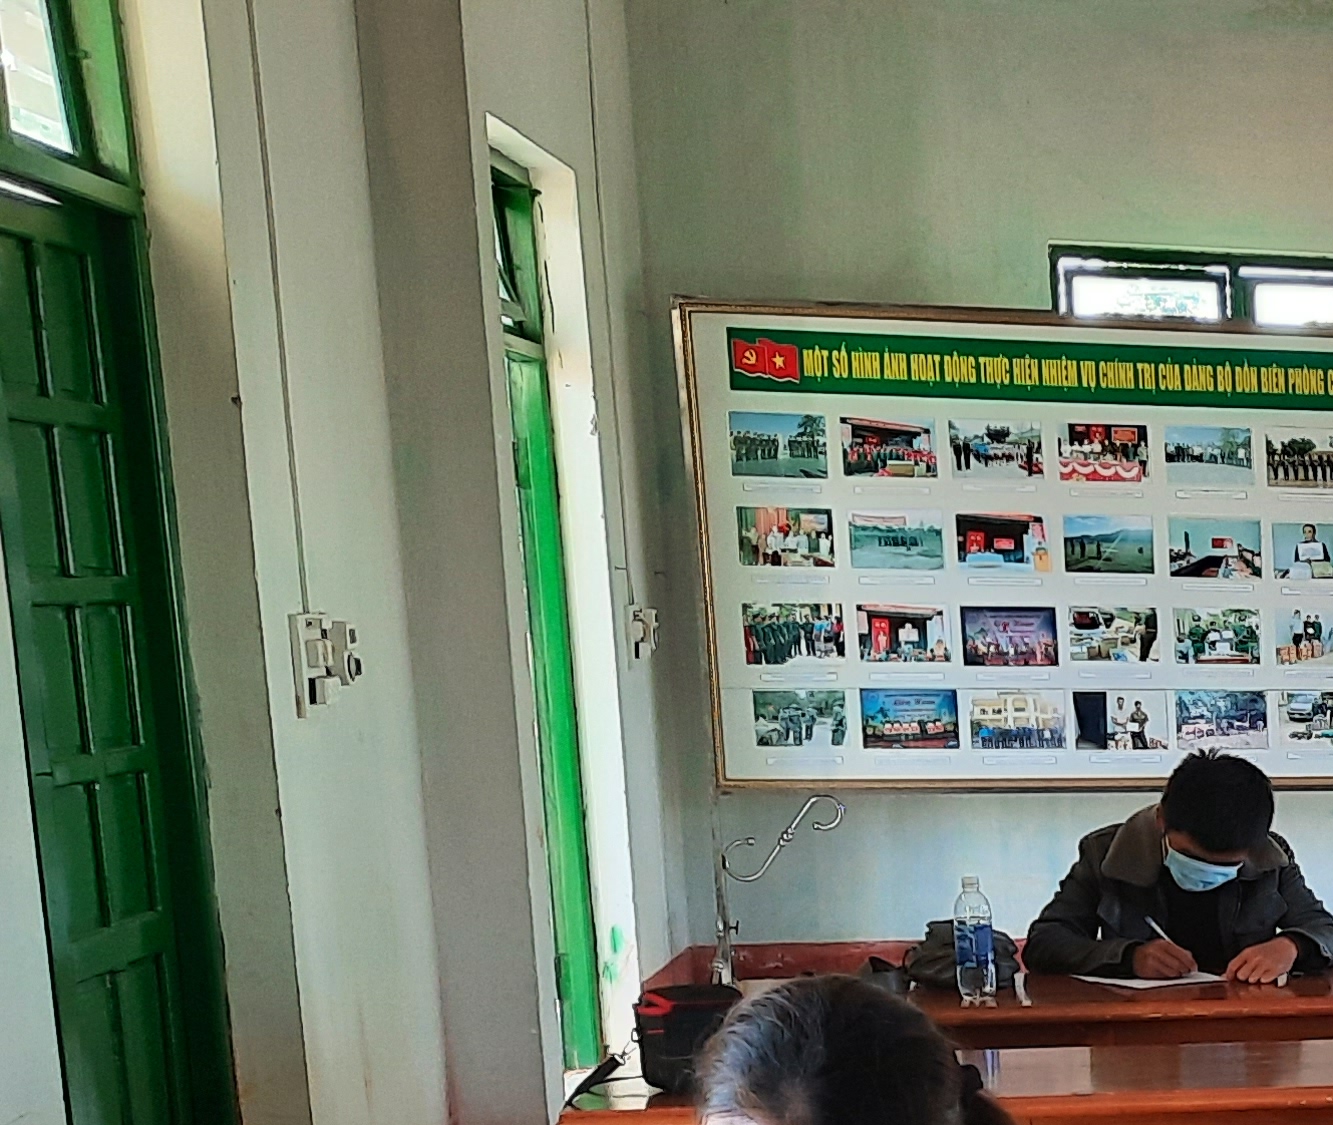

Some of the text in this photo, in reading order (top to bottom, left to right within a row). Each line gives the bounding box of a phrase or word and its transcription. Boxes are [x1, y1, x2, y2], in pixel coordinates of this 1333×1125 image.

[803, 345, 829, 383] MỘT
[832, 341, 849, 379] SỐ
[851, 346, 881, 379] HÌNH
[884, 346, 908, 380] ẢNH
[911, 353, 941, 387] HOẠT
[944, 350, 976, 388] ĐỘNG
[978, 353, 1010, 389] THỰC
[1012, 354, 1039, 391] HIỆN
[1041, 354, 1078, 391] NHIỆM
[1080, 360, 1096, 393] VỤ
[1099, 358, 1135, 389] CHÍNH
[1137, 362, 1156, 395] TRỊ
[1158, 357, 1182, 391] CỦA
[1216, 360, 1233, 397] BỘ
[1288, 363, 1325, 396] PHÒNG
